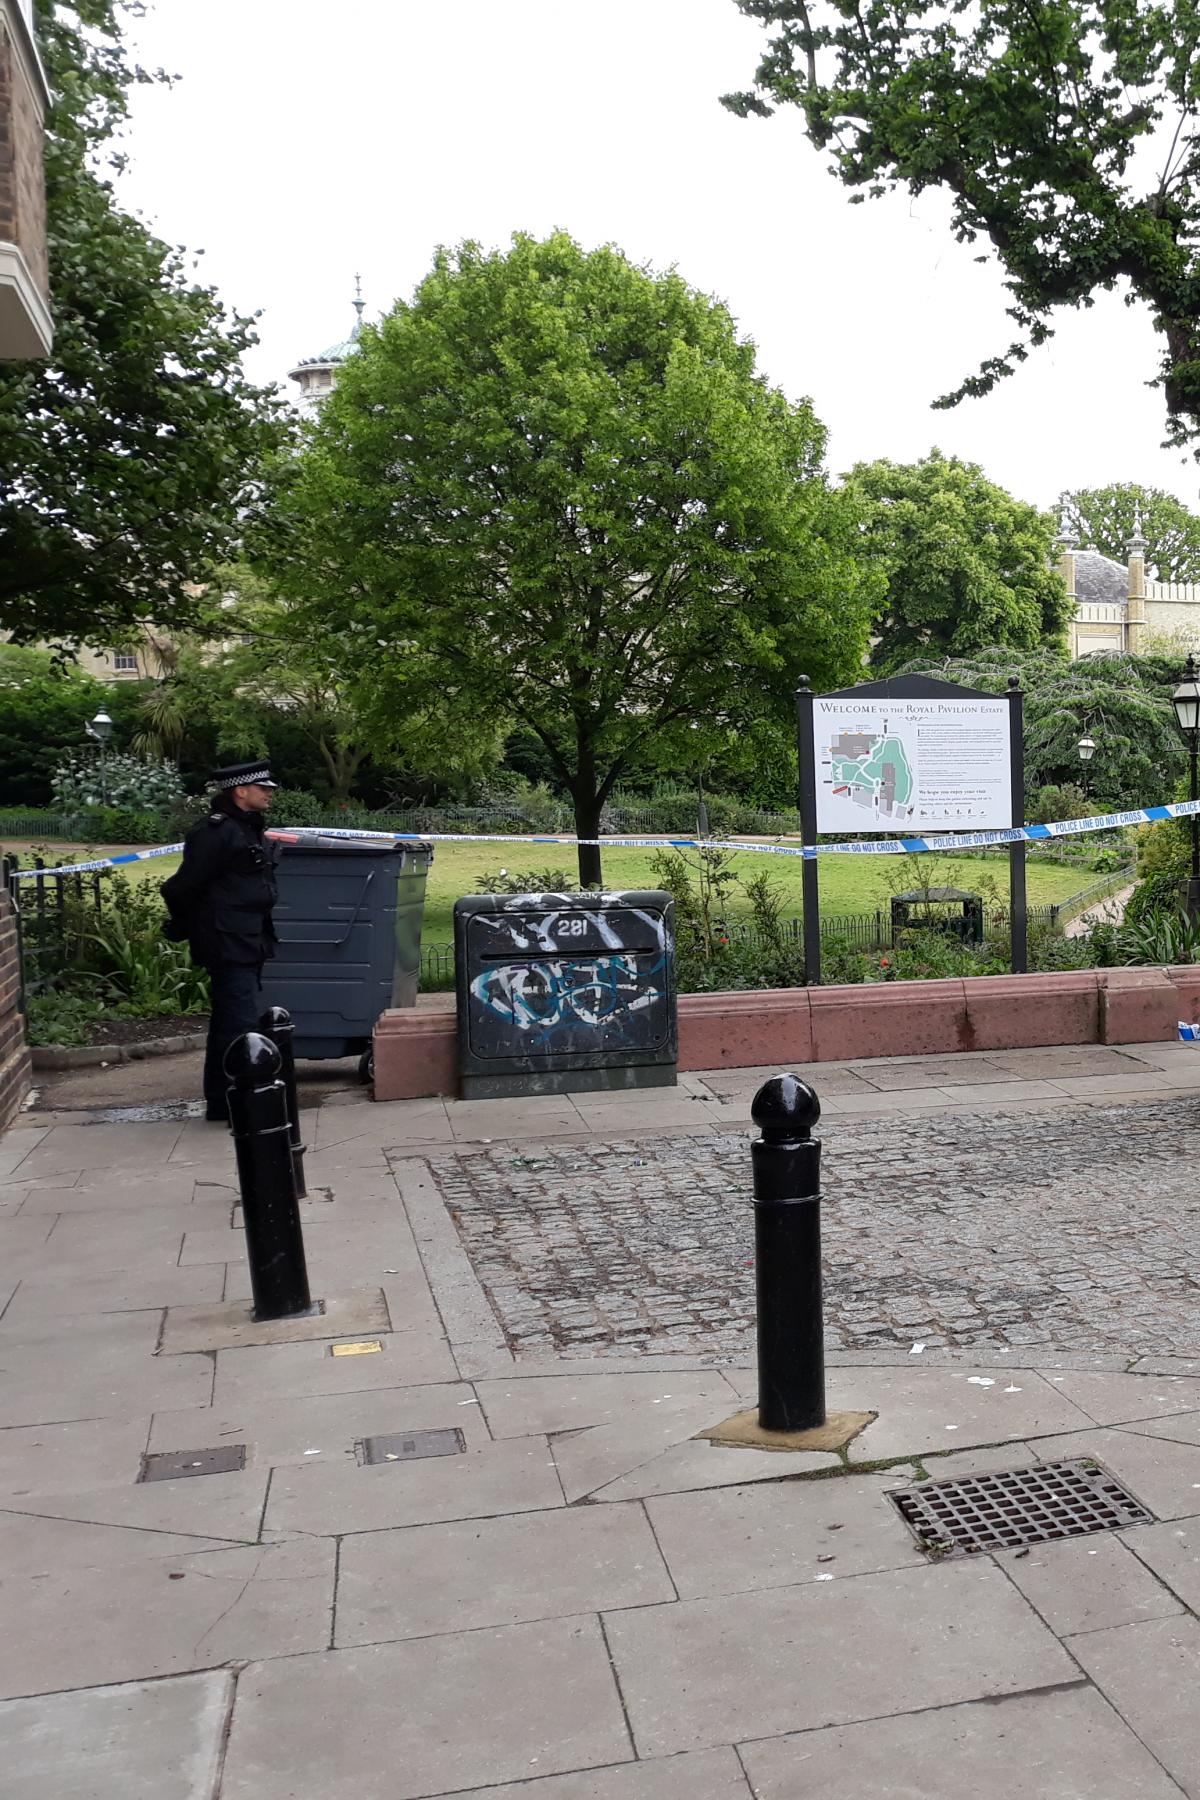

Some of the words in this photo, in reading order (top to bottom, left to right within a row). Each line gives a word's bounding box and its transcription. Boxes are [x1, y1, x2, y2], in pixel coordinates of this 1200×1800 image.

[1175, 800, 1199, 814] POLICE
[1055, 821, 1078, 834] POLICE
[1078, 818, 1094, 830] LINE
[1095, 817, 1105, 828] DO
[1105, 814, 1119, 826] NOT
[1120, 811, 1142, 824] CROSS
[862, 843, 876, 852] NOT
[876, 841, 899, 852] CROSS
[933, 838, 957, 848] POLICE
[957, 836, 973, 846] LINE
[974, 834, 984, 844] DO
[984, 831, 998, 842] NOT
[999, 829, 1022, 841] CROSS
[558, 919, 588, 936] 281
